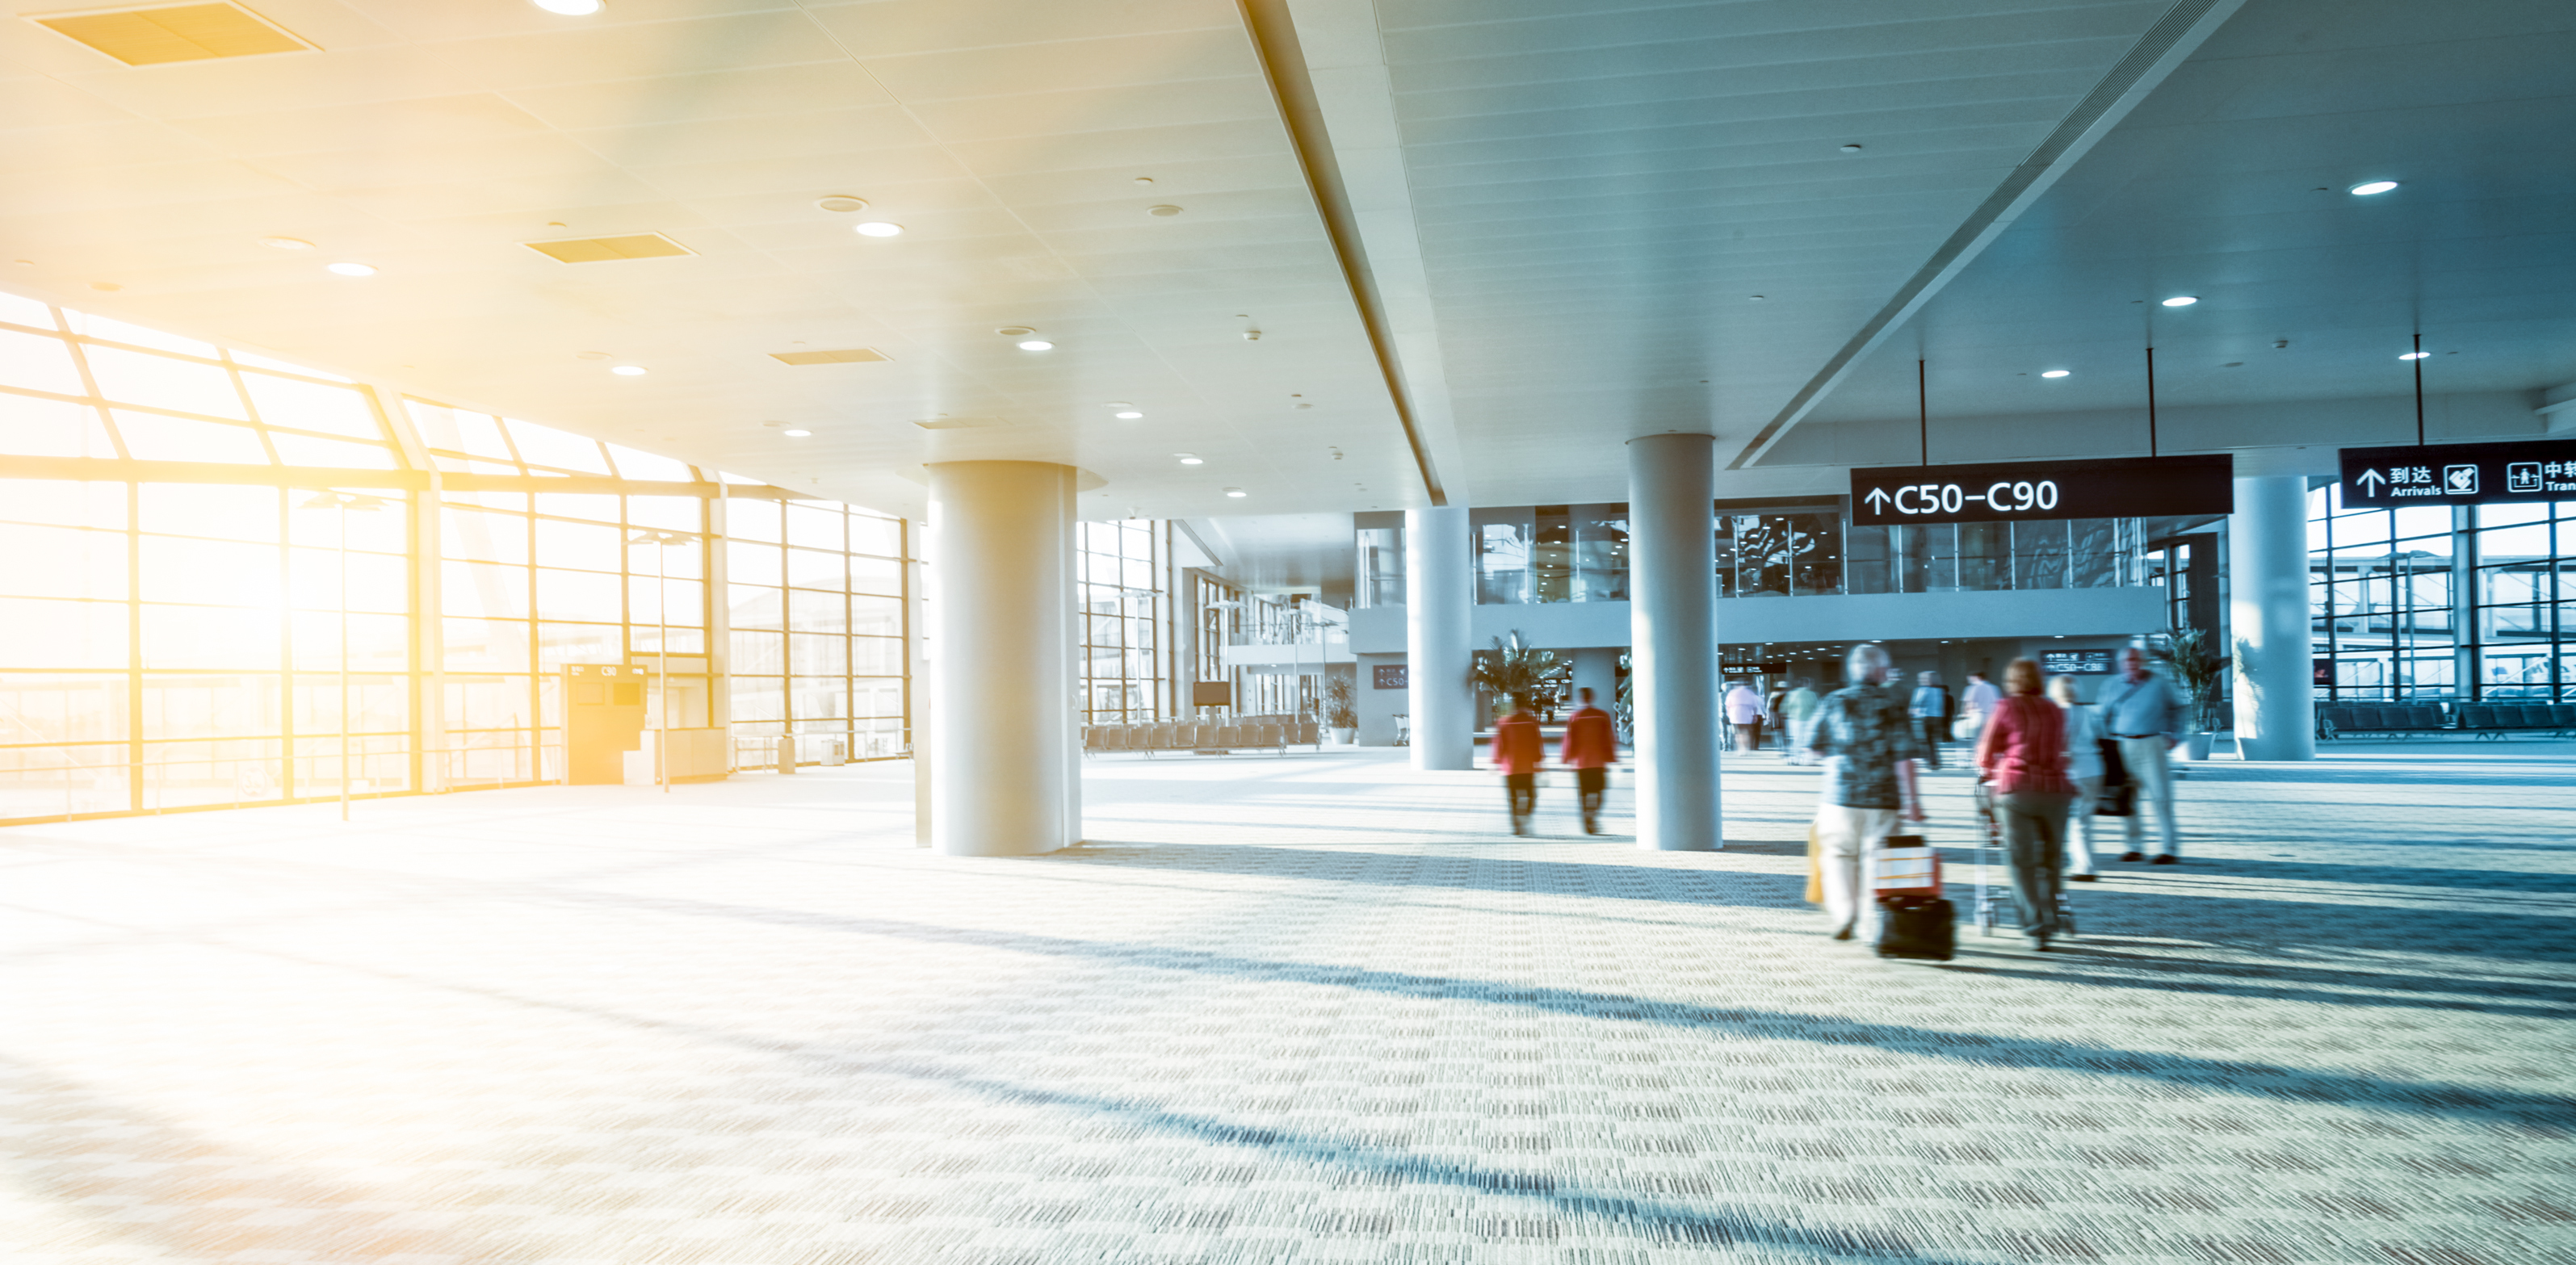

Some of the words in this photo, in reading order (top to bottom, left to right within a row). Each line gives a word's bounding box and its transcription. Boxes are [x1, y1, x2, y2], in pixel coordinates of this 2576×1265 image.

[2390, 467, 2431, 484] 到达
[2390, 485, 2442, 496] Arrivals
[2545, 481, 2576, 491] Tran
[1894, 480, 2058, 514] C50-C90
